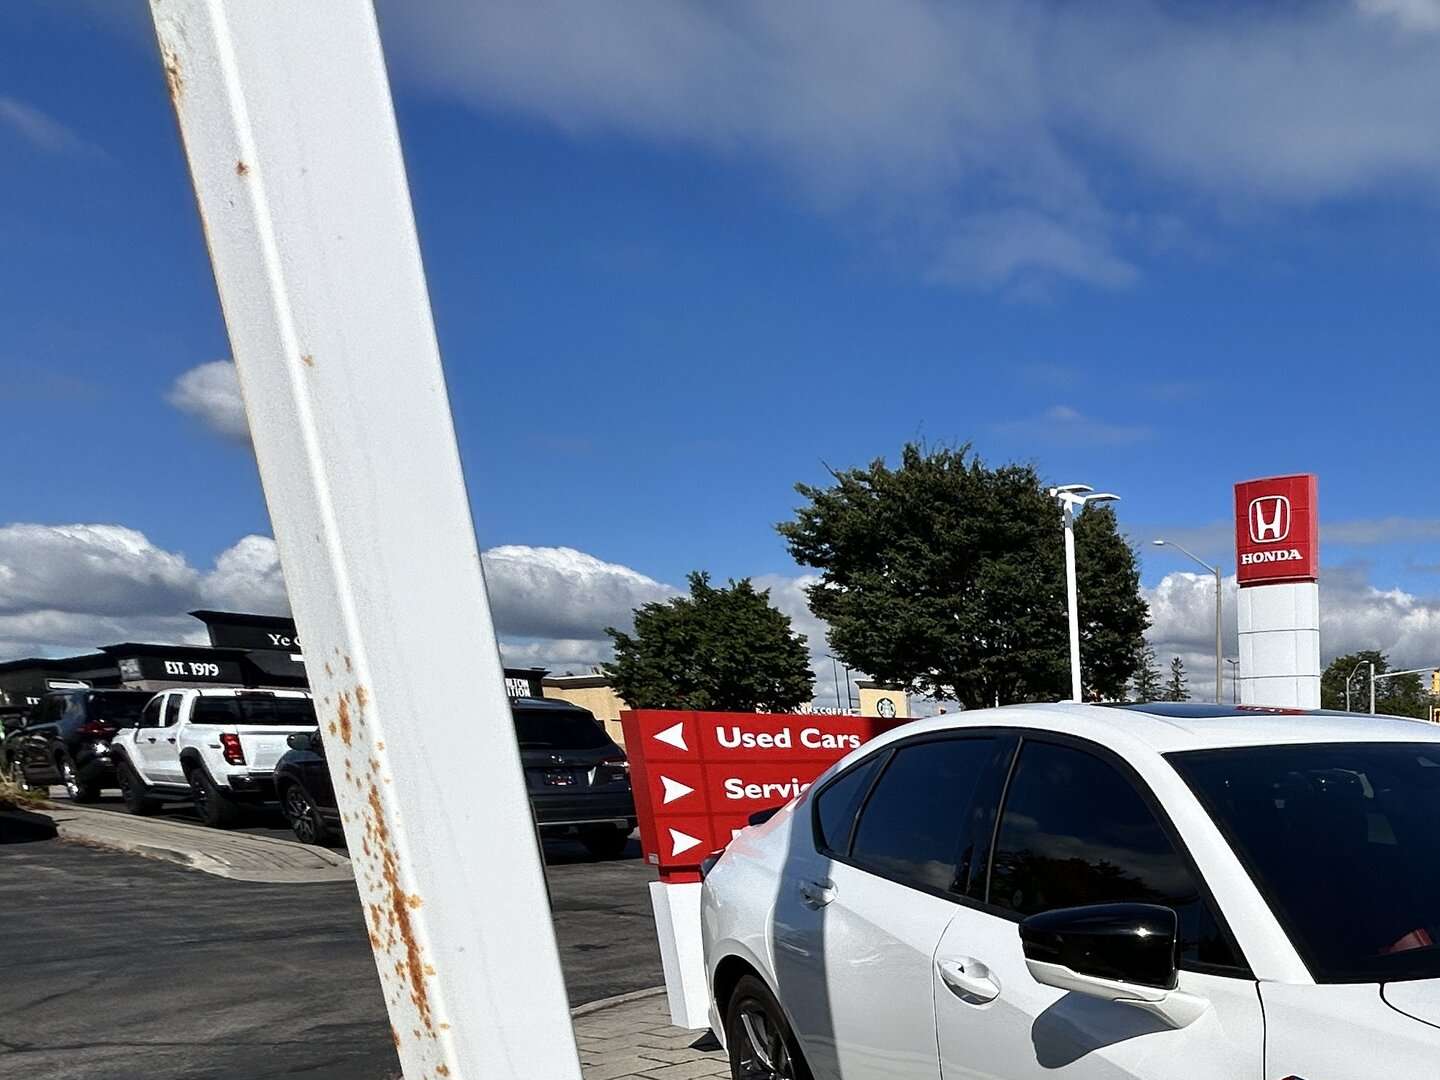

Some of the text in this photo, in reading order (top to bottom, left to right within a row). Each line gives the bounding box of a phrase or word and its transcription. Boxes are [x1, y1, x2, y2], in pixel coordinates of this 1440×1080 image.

[1241, 548, 1303, 565] HONDA
[164, 661, 219, 676] EST. 1979
[716, 726, 862, 750] Used Cars
